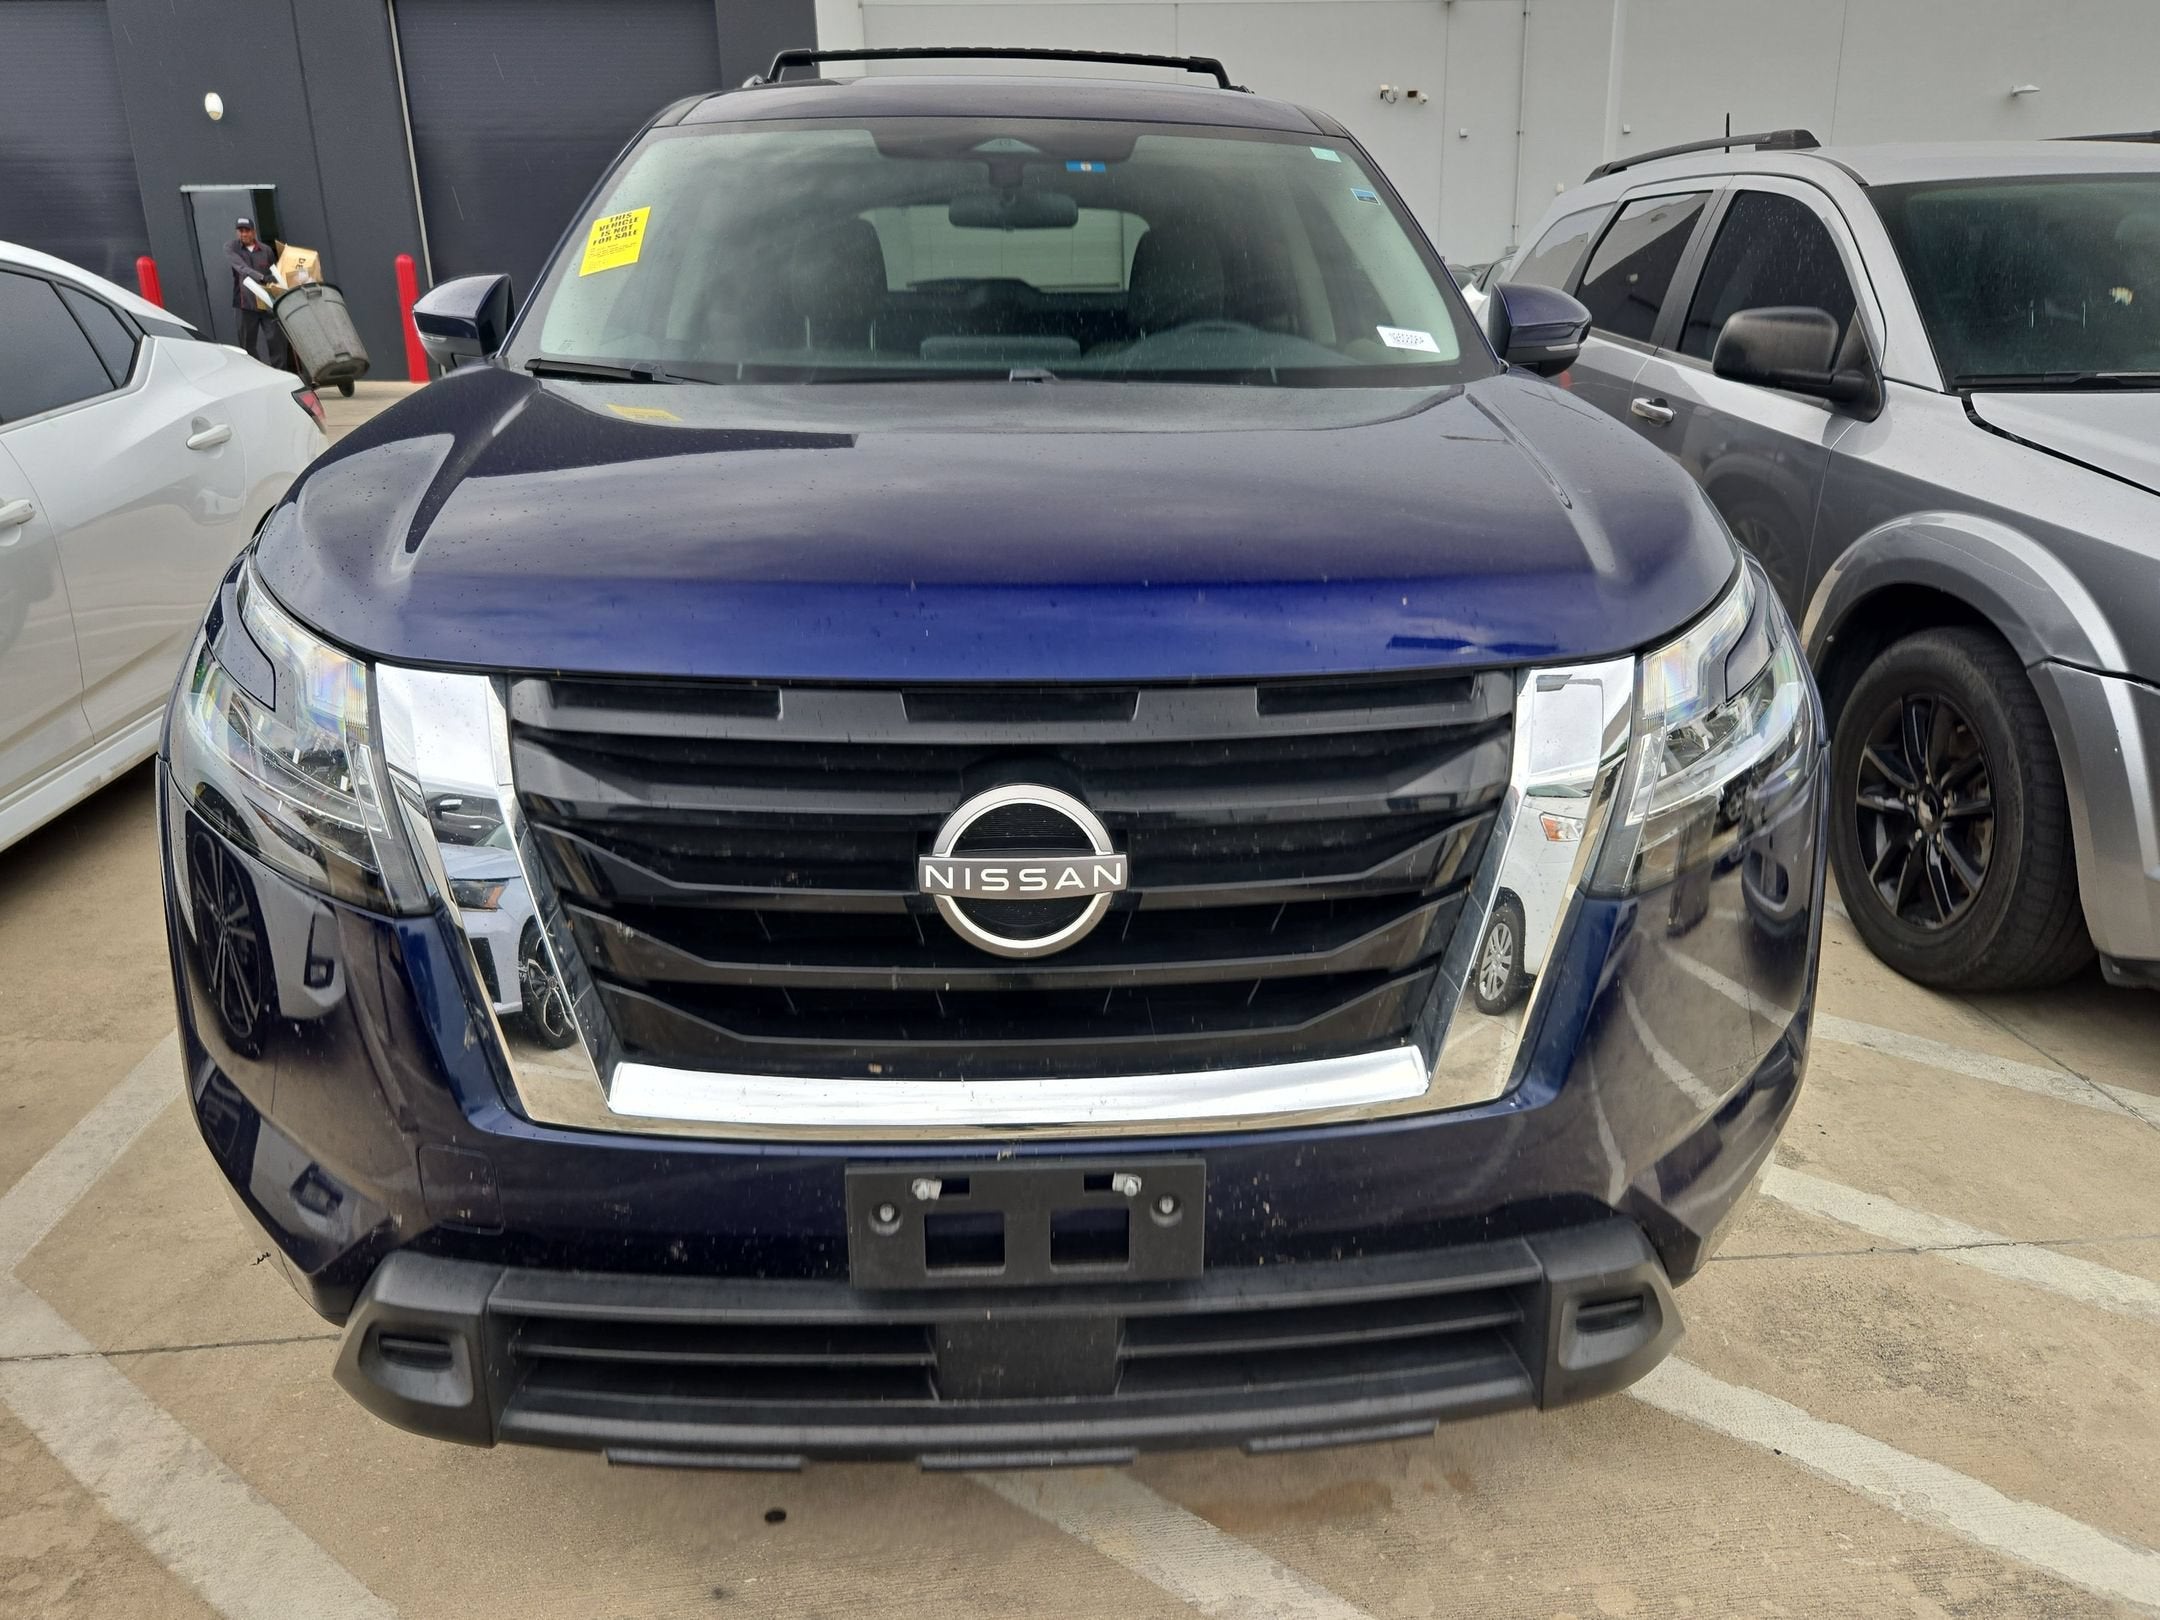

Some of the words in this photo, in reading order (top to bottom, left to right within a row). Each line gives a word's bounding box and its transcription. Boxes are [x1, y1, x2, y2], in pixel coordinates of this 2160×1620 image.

[599, 217, 638, 231] VEHICLE
[610, 213, 632, 222] THIS
[613, 224, 633, 234] NOT
[593, 236, 611, 245] FOR
[614, 230, 637, 240] SALE
[925, 862, 1122, 892] NISSAN
